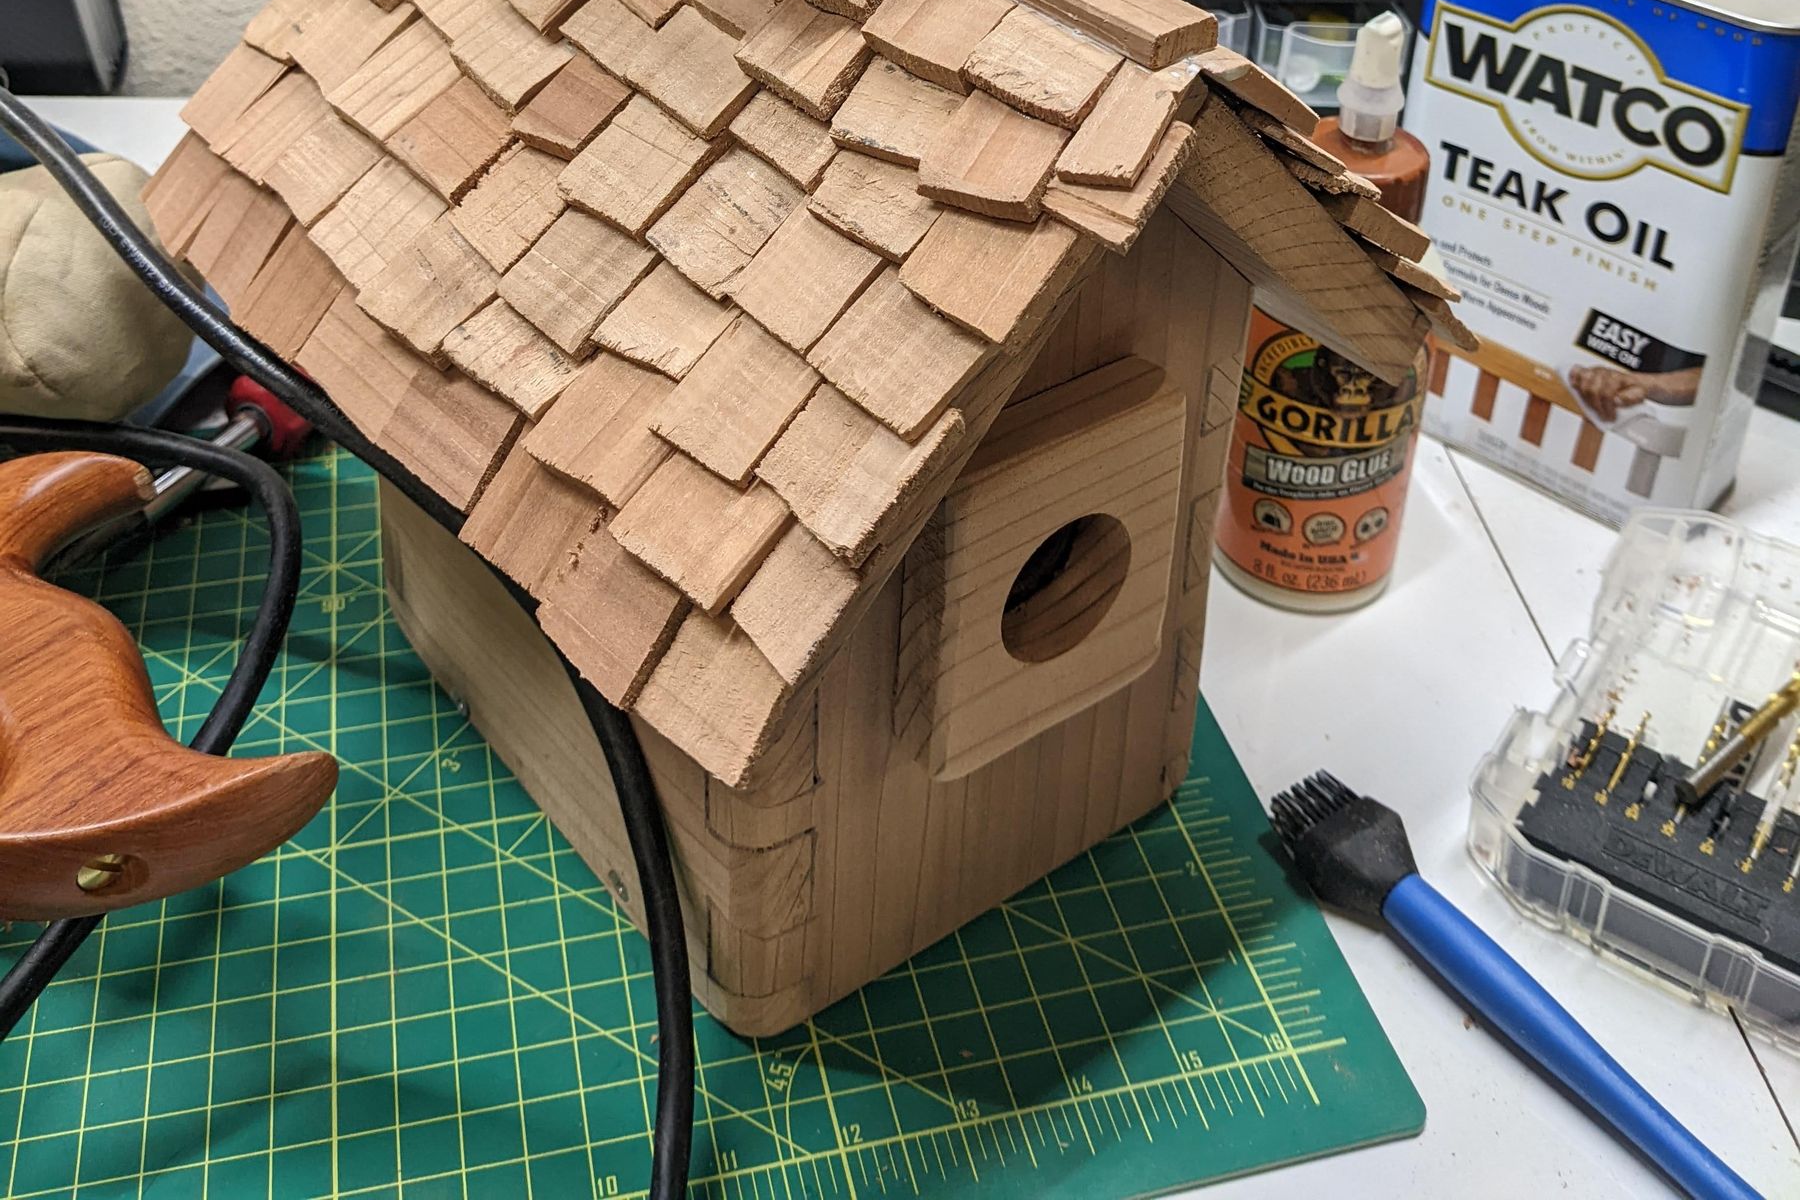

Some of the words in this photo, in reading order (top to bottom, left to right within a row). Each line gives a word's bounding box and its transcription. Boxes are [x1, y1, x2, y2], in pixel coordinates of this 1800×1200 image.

[1444, 20, 1726, 168] WATCO
[1522, 118, 1559, 152] FROM
[1440, 140, 1569, 224] TEAK
[1585, 201, 1675, 271] OIL
[1442, 195, 1488, 221] ONE
[1502, 218, 1557, 246] STEP
[1571, 246, 1659, 292] FINISH
[1591, 315, 1651, 355] EASY
[1618, 349, 1641, 369] ON
[1257, 395, 1414, 442] GORILLA
[1253, 559, 1263, 574] 8
[1185, 860, 1199, 877] 2
[1263, 1032, 1285, 1052] 16
[1181, 1050, 1204, 1071] 15
[1071, 1073, 1094, 1095] 14
[958, 1099, 981, 1121] 13
[841, 1123, 864, 1145] 12
[722, 1149, 738, 1171] 11
[597, 1174, 619, 1198] 10
